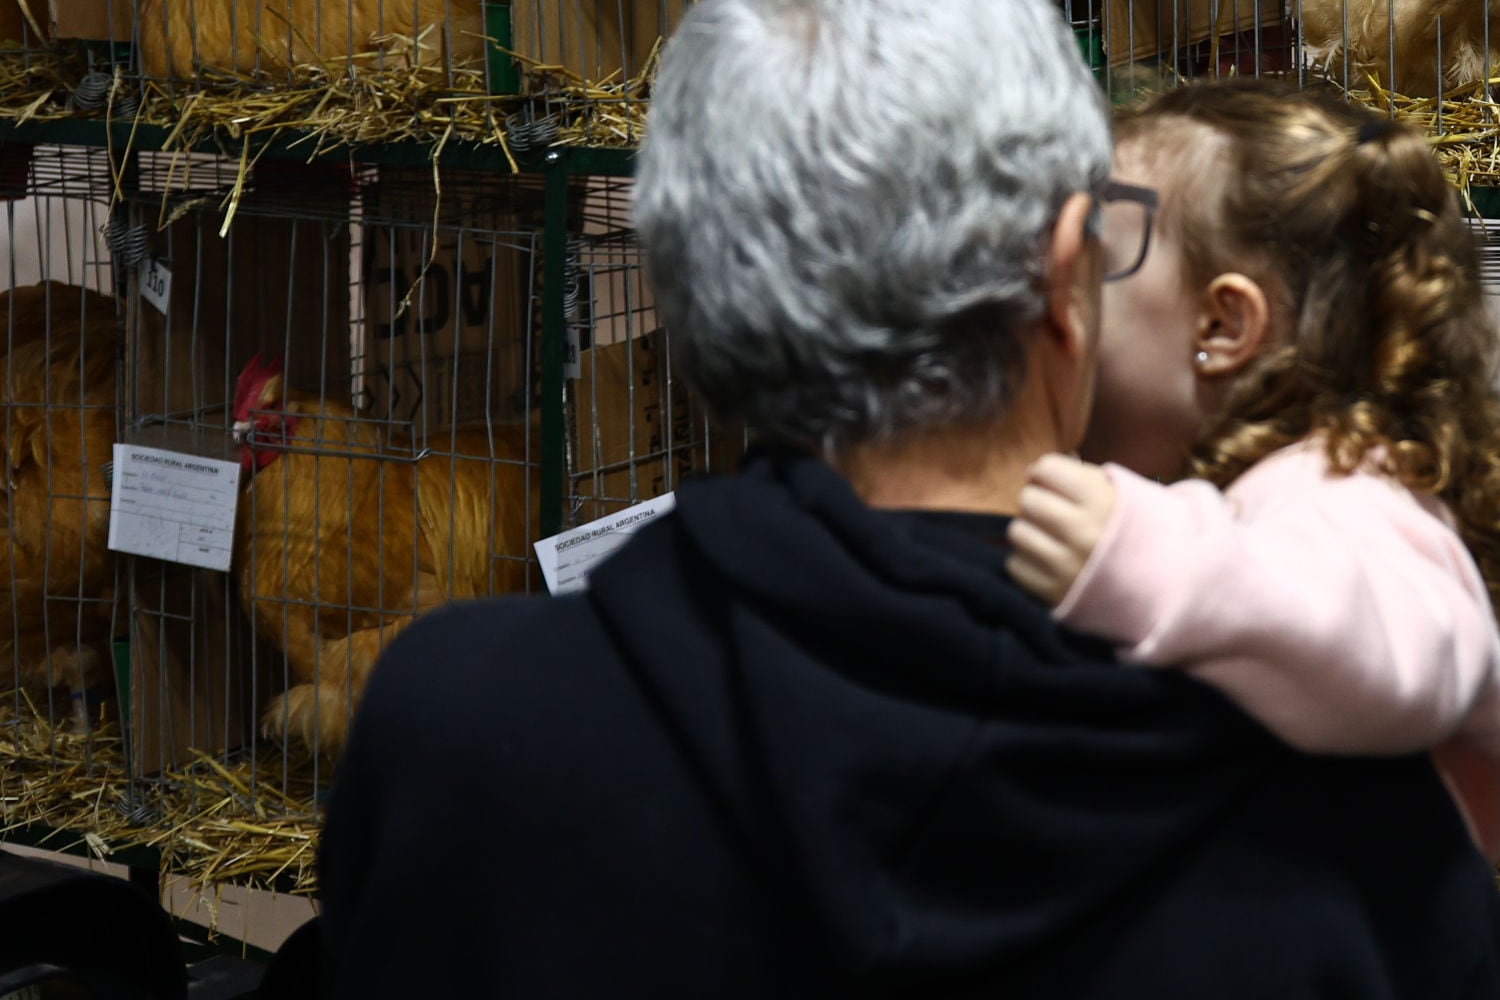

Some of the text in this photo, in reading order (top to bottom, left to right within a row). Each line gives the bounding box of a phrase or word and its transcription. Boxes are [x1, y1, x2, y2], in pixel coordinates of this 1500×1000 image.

[554, 508, 656, 552] SOCIEDAD RURAL ARGENTINA
